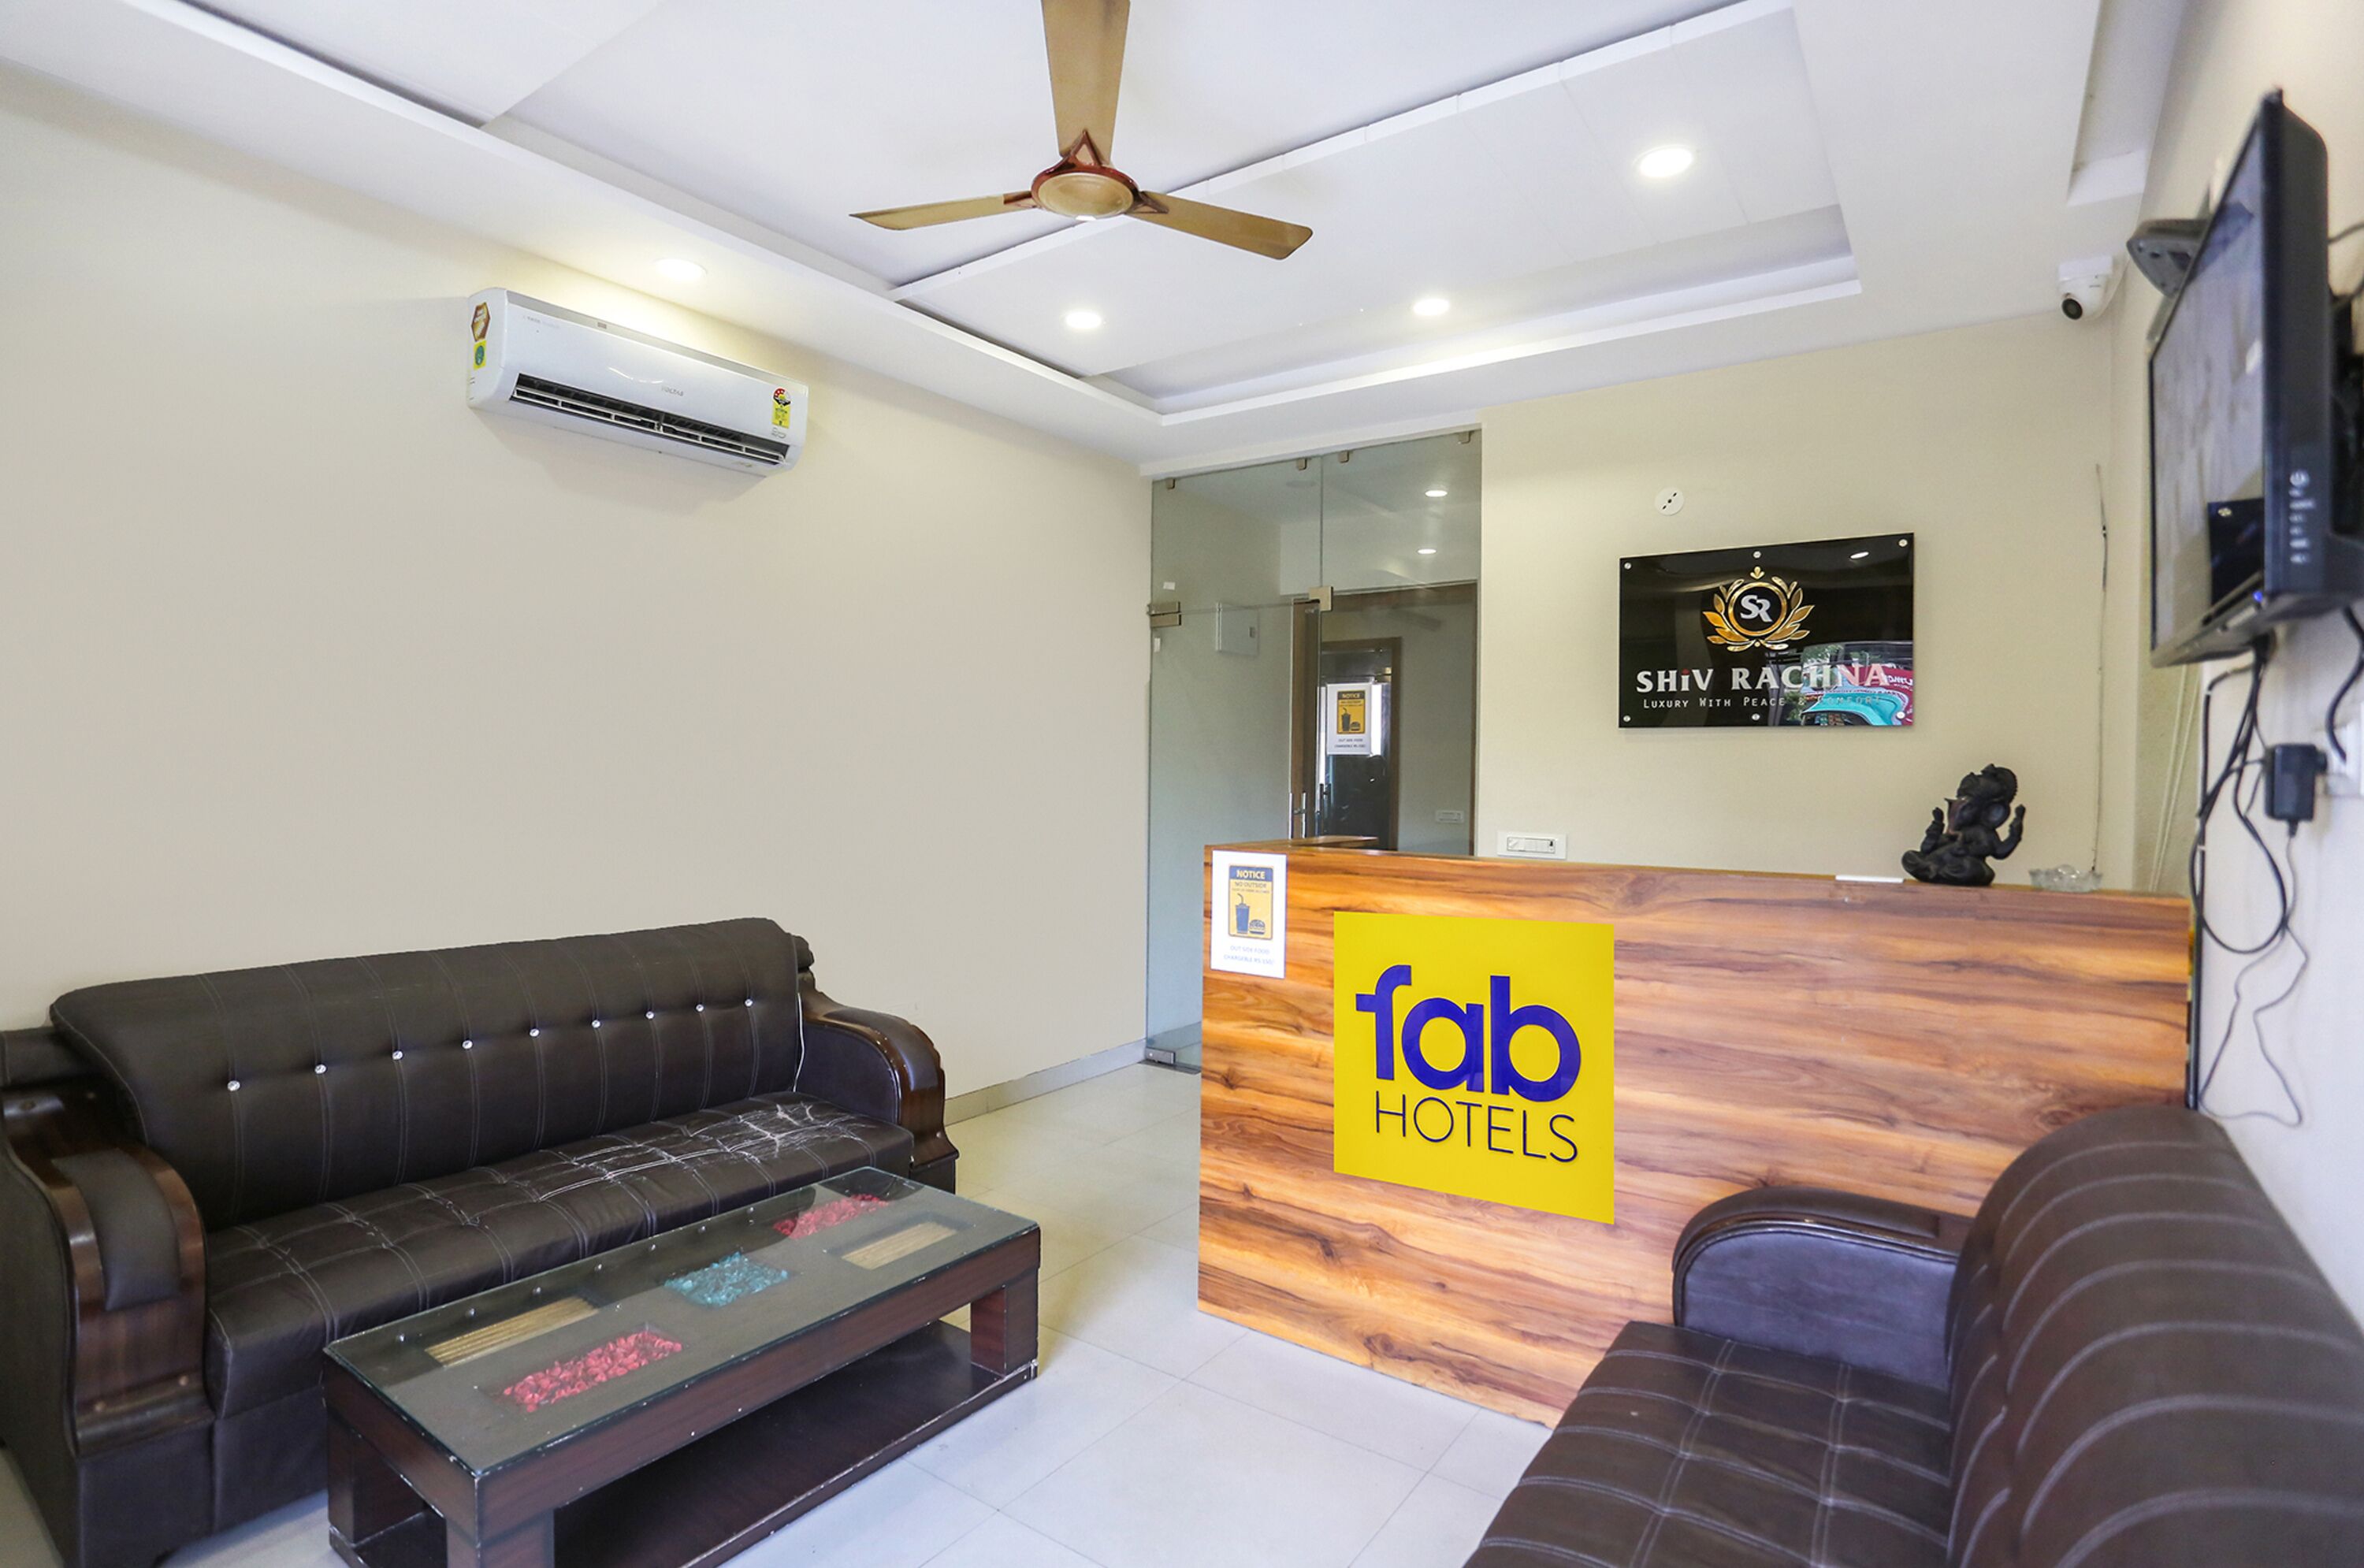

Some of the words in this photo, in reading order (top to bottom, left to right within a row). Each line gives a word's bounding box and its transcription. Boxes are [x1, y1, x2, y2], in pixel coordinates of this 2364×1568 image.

[1740, 594, 1772, 622] SR
[1731, 663, 1890, 690] RACHNA
[1236, 869, 1266, 879] NOTICE
[1355, 964, 1581, 1102] fab
[1376, 1091, 1578, 1163] HOTELS
